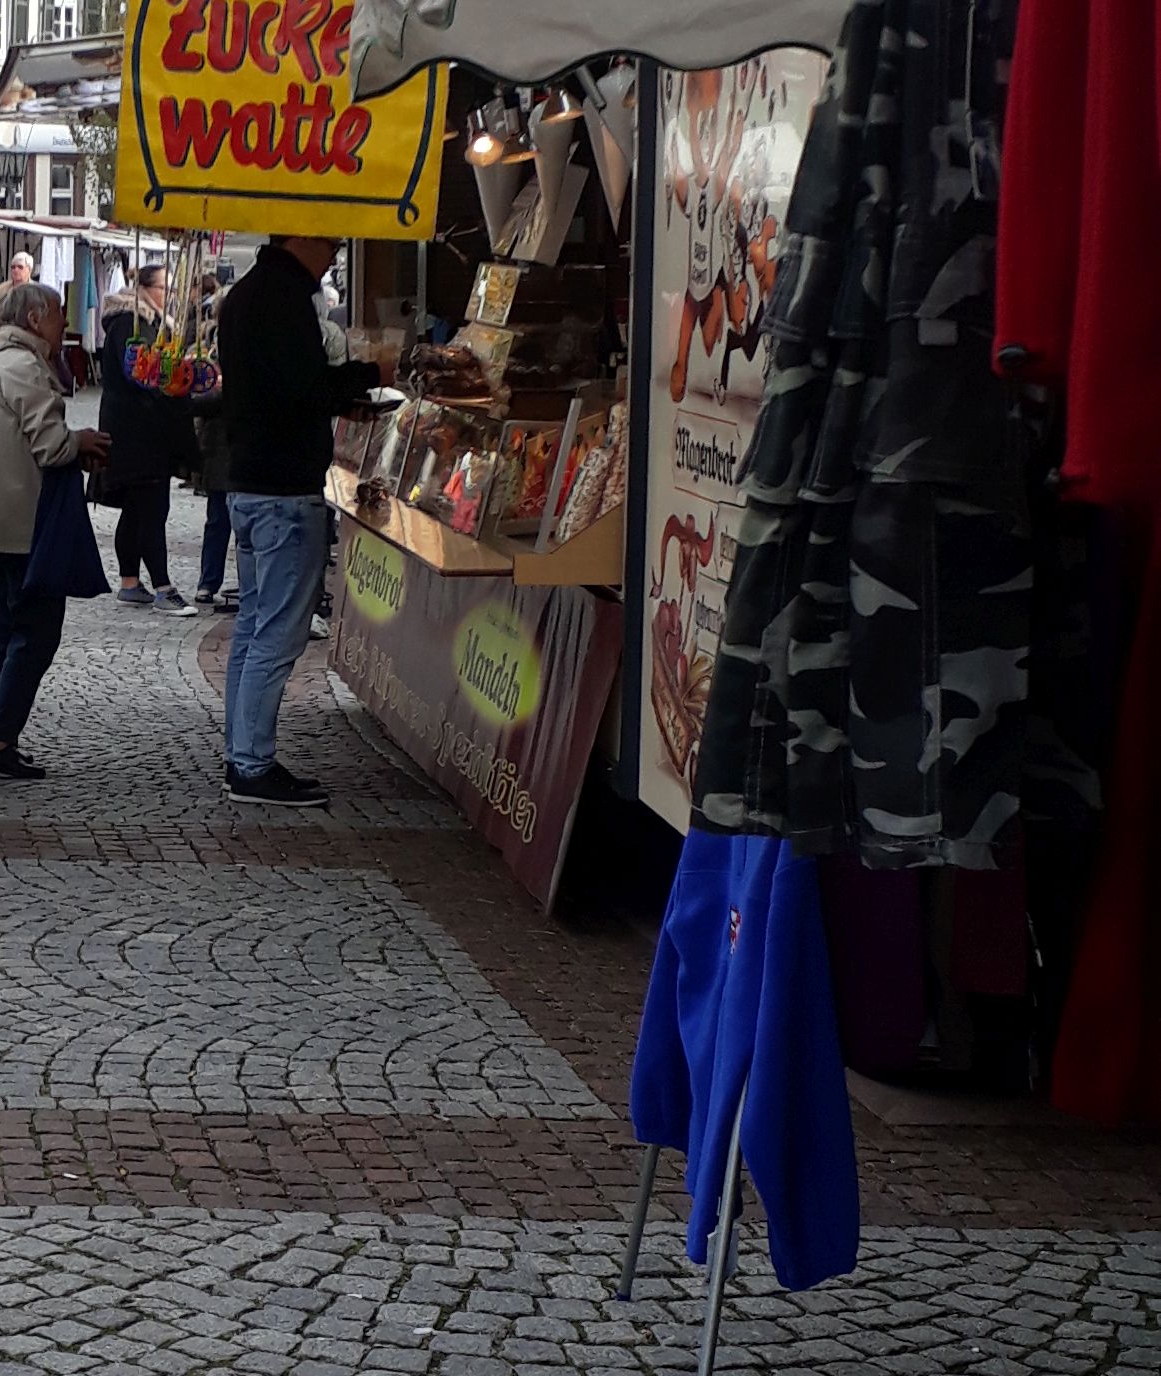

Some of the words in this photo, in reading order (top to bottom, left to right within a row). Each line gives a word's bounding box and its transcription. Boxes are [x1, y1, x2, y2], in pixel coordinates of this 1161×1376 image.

[159, 83, 373, 176] watte
[675, 426, 737, 488] Magenbrot
[344, 535, 404, 612] Magenbrot
[458, 626, 522, 721] Mandeln
